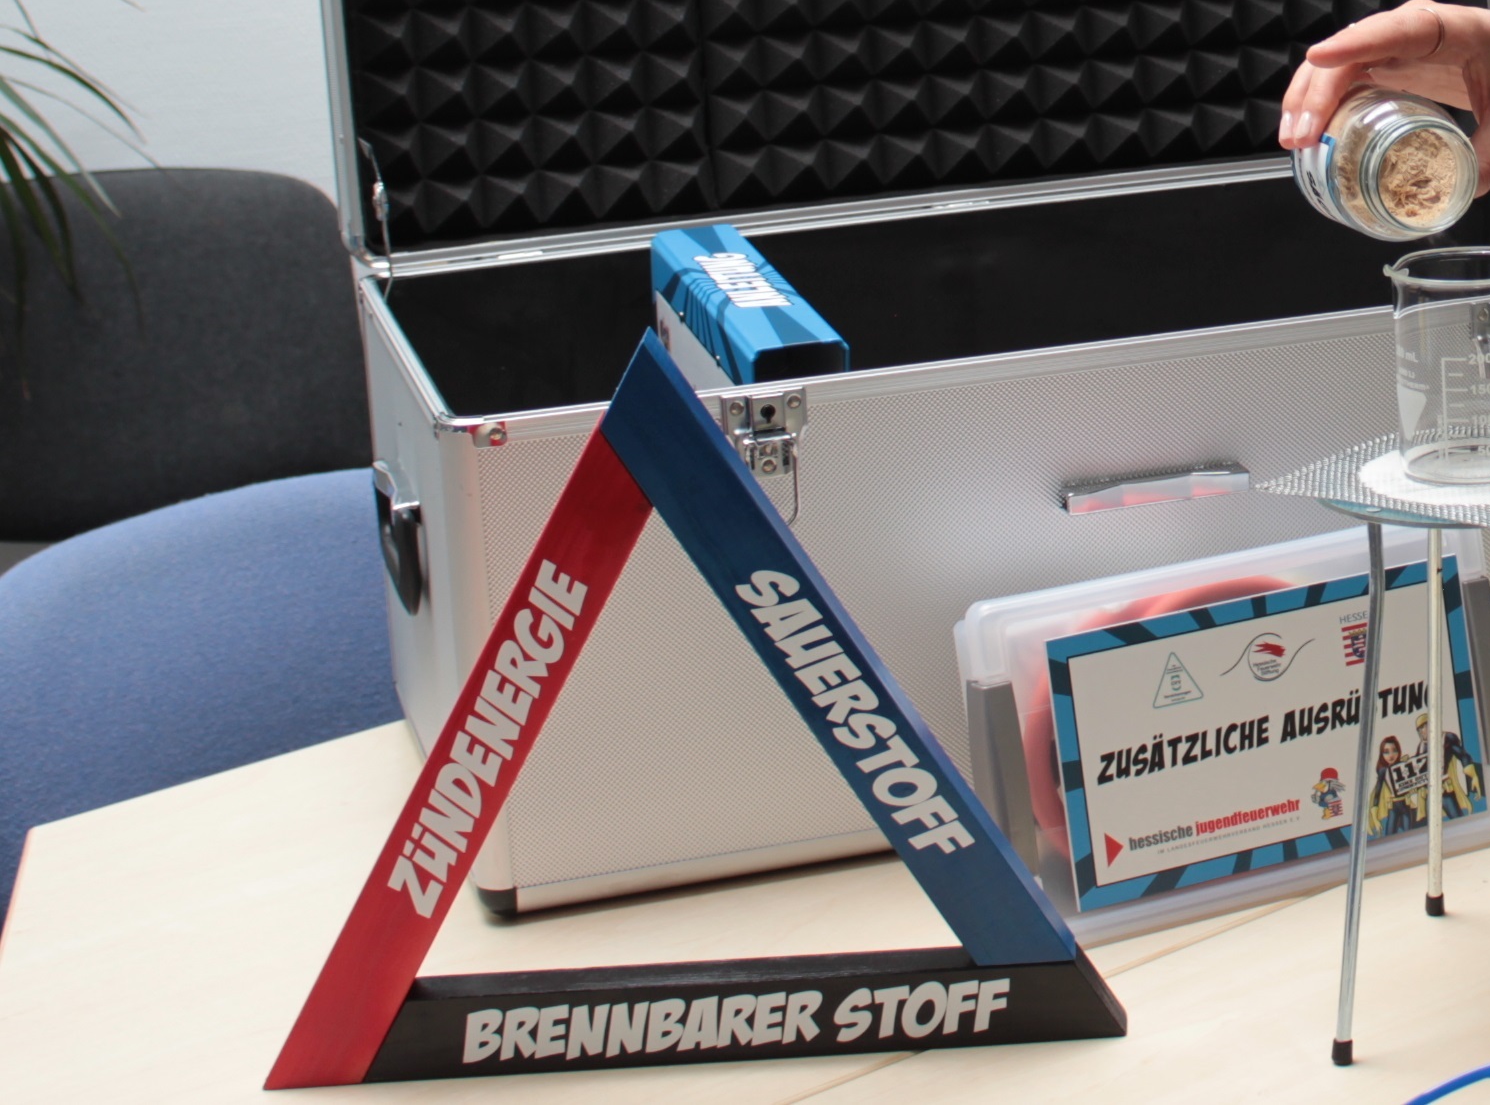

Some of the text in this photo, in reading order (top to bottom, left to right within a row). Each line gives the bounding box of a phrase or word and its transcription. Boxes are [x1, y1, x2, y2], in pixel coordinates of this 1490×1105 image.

[1339, 611, 1368, 624] HESSE
[387, 560, 588, 919] ZÜNDENERGIE
[734, 569, 975, 855] SAUERSTOFF
[1097, 680, 1428, 786] ZUSÄTZLICHE AUSRÜTUN
[1129, 799, 1300, 851] hessische jugendfeuerwehr
[462, 978, 1010, 1064] BRENNBARER STOFF
